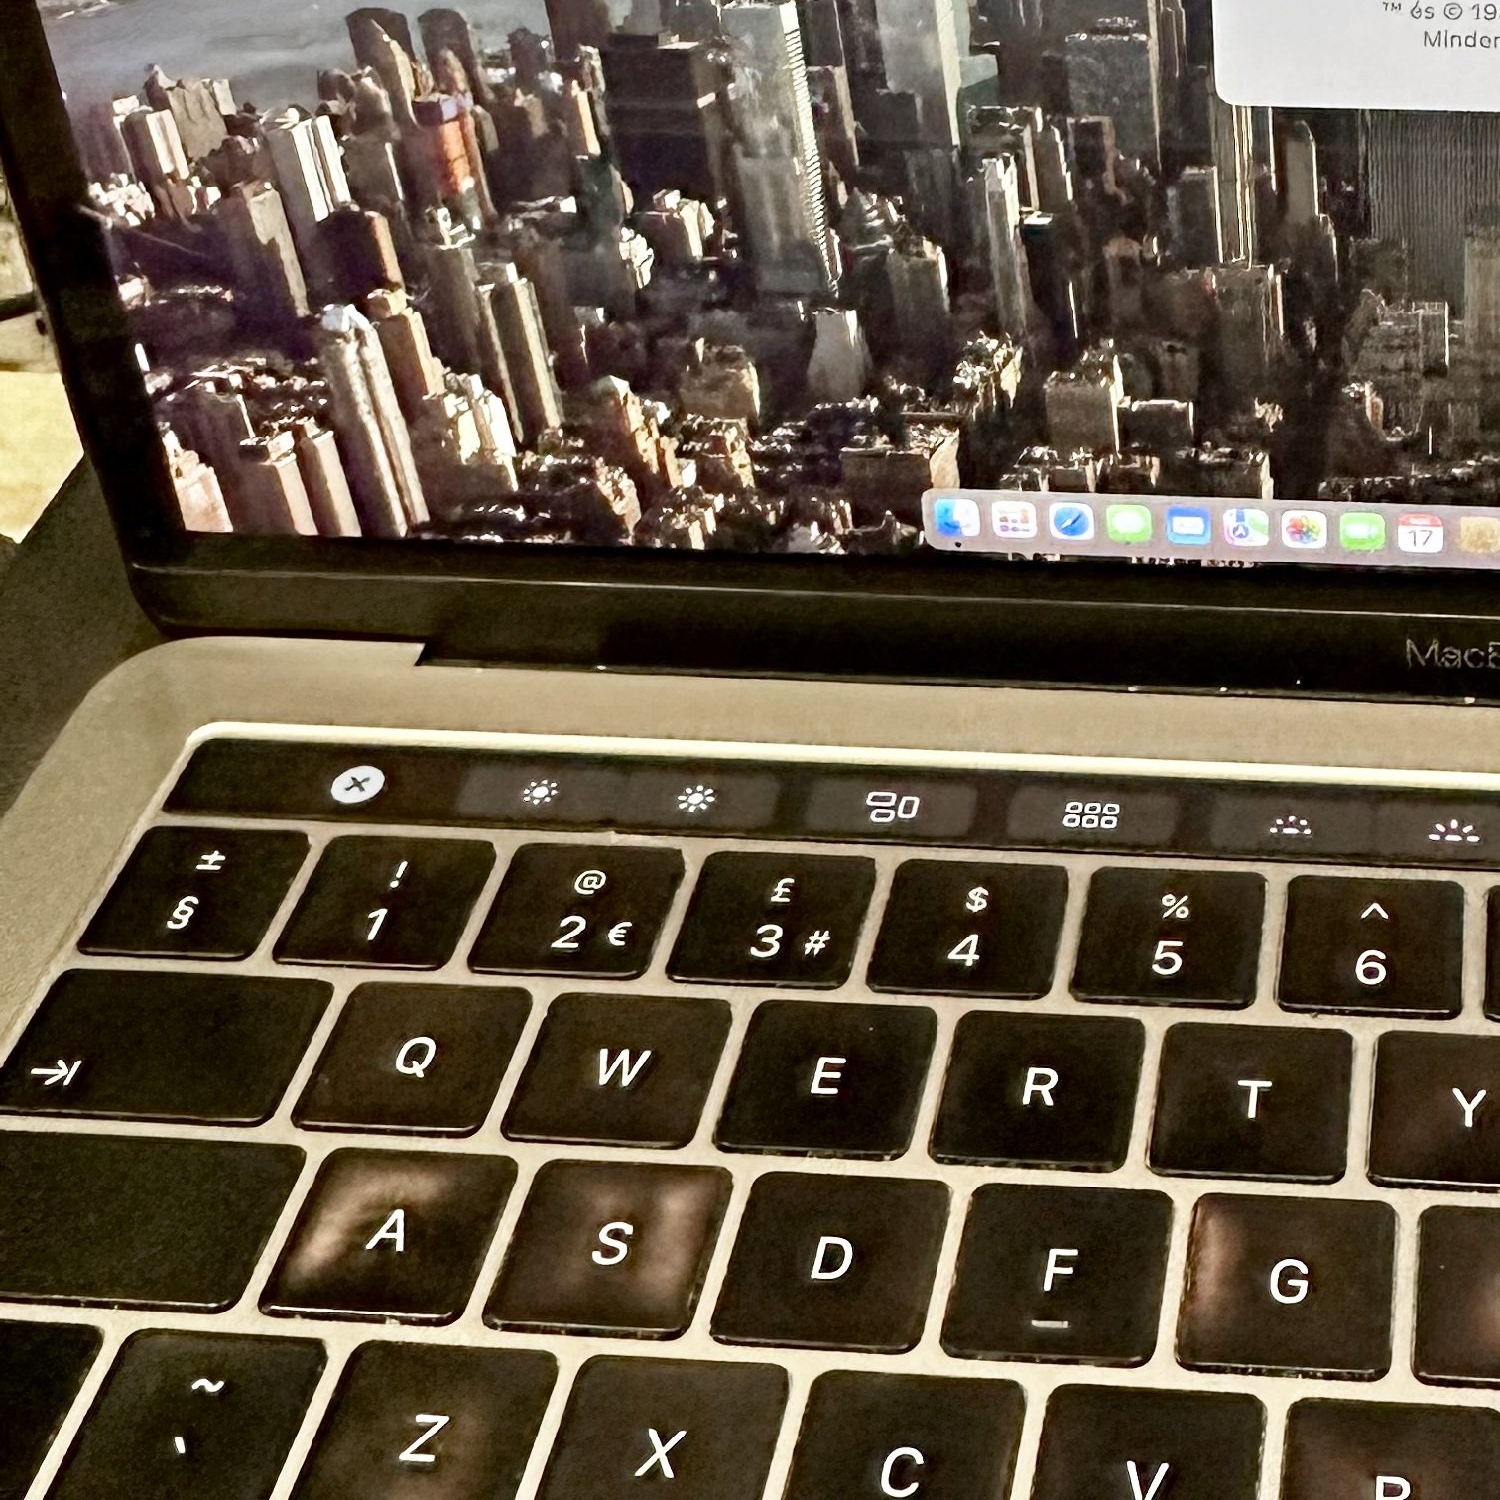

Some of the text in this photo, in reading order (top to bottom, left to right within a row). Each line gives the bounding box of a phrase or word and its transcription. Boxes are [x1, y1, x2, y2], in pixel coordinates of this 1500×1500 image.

[1408, 529, 1434, 548] 17
[573, 869, 607, 895] @
[770, 877, 795, 903] £
[965, 886, 989, 913] $
[367, 908, 388, 941] 1
[1161, 893, 1189, 919] %
[551, 916, 632, 948] 2 €
[750, 925, 830, 957] 3 #
[947, 934, 980, 967] 4
[1151, 940, 1184, 976] 5
[1355, 949, 1387, 985] 6
[395, 1036, 437, 1078] Q
[598, 1048, 652, 1087] W
[810, 1056, 847, 1095] E
[1022, 1066, 1059, 1106] R
[1237, 1079, 1273, 1119] T
[1452, 1087, 1487, 1128] Y
[365, 1208, 405, 1252] A
[591, 1221, 634, 1266] S
[810, 1236, 853, 1280] D
[1043, 1248, 1079, 1292] F
[1269, 1258, 1309, 1304] G
[398, 1413, 450, 1463] Z
[634, 1428, 688, 1479] X
[880, 1446, 925, 1498] C
[1126, 1460, 1170, 1500] V
